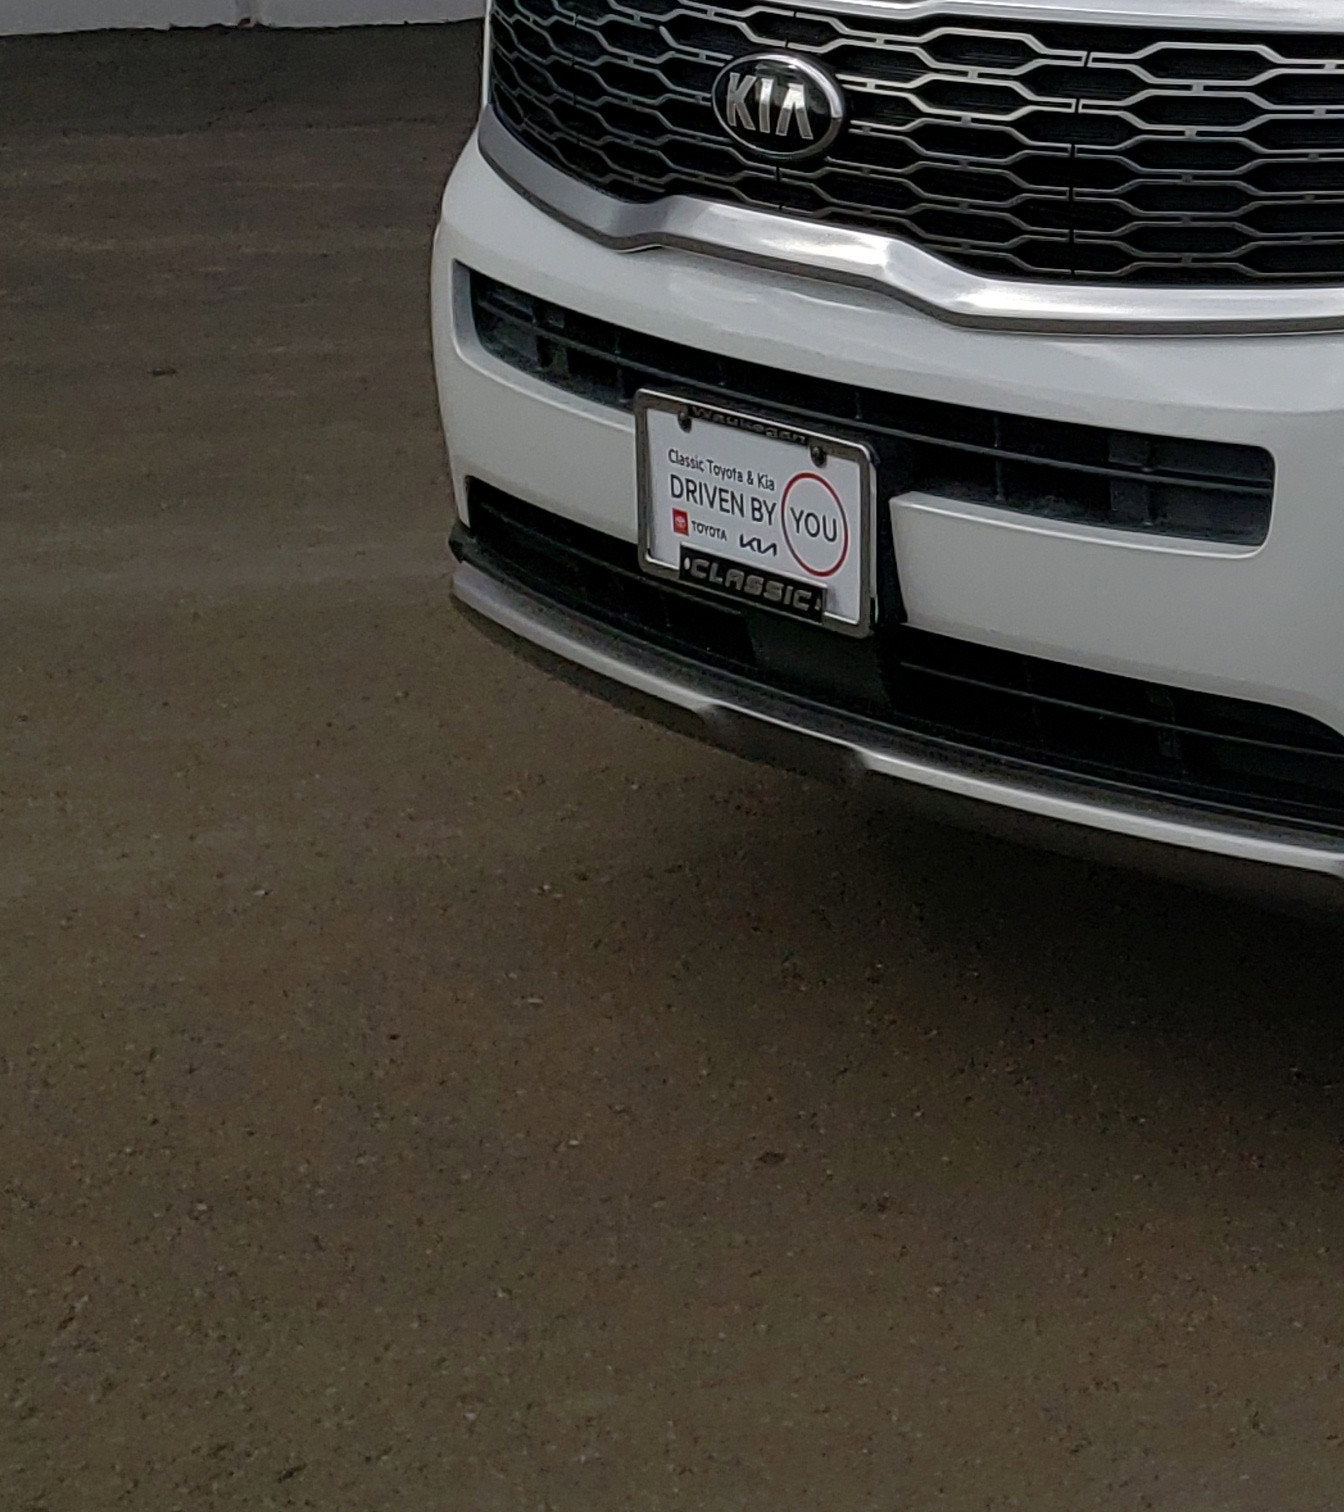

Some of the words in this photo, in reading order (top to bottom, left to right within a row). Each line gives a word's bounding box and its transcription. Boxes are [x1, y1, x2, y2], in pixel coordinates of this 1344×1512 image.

[726, 72, 814, 140] KIA
[668, 448, 704, 472] Classic
[706, 459, 743, 482] Toyota
[747, 470, 754, 485] &
[757, 473, 775, 491] Kia
[670, 474, 744, 518] DRIVEN
[751, 496, 777, 526] BY
[790, 507, 837, 542] YOU
[691, 520, 727, 541] TOYOTA
[690, 558, 812, 611] CLASSIC
